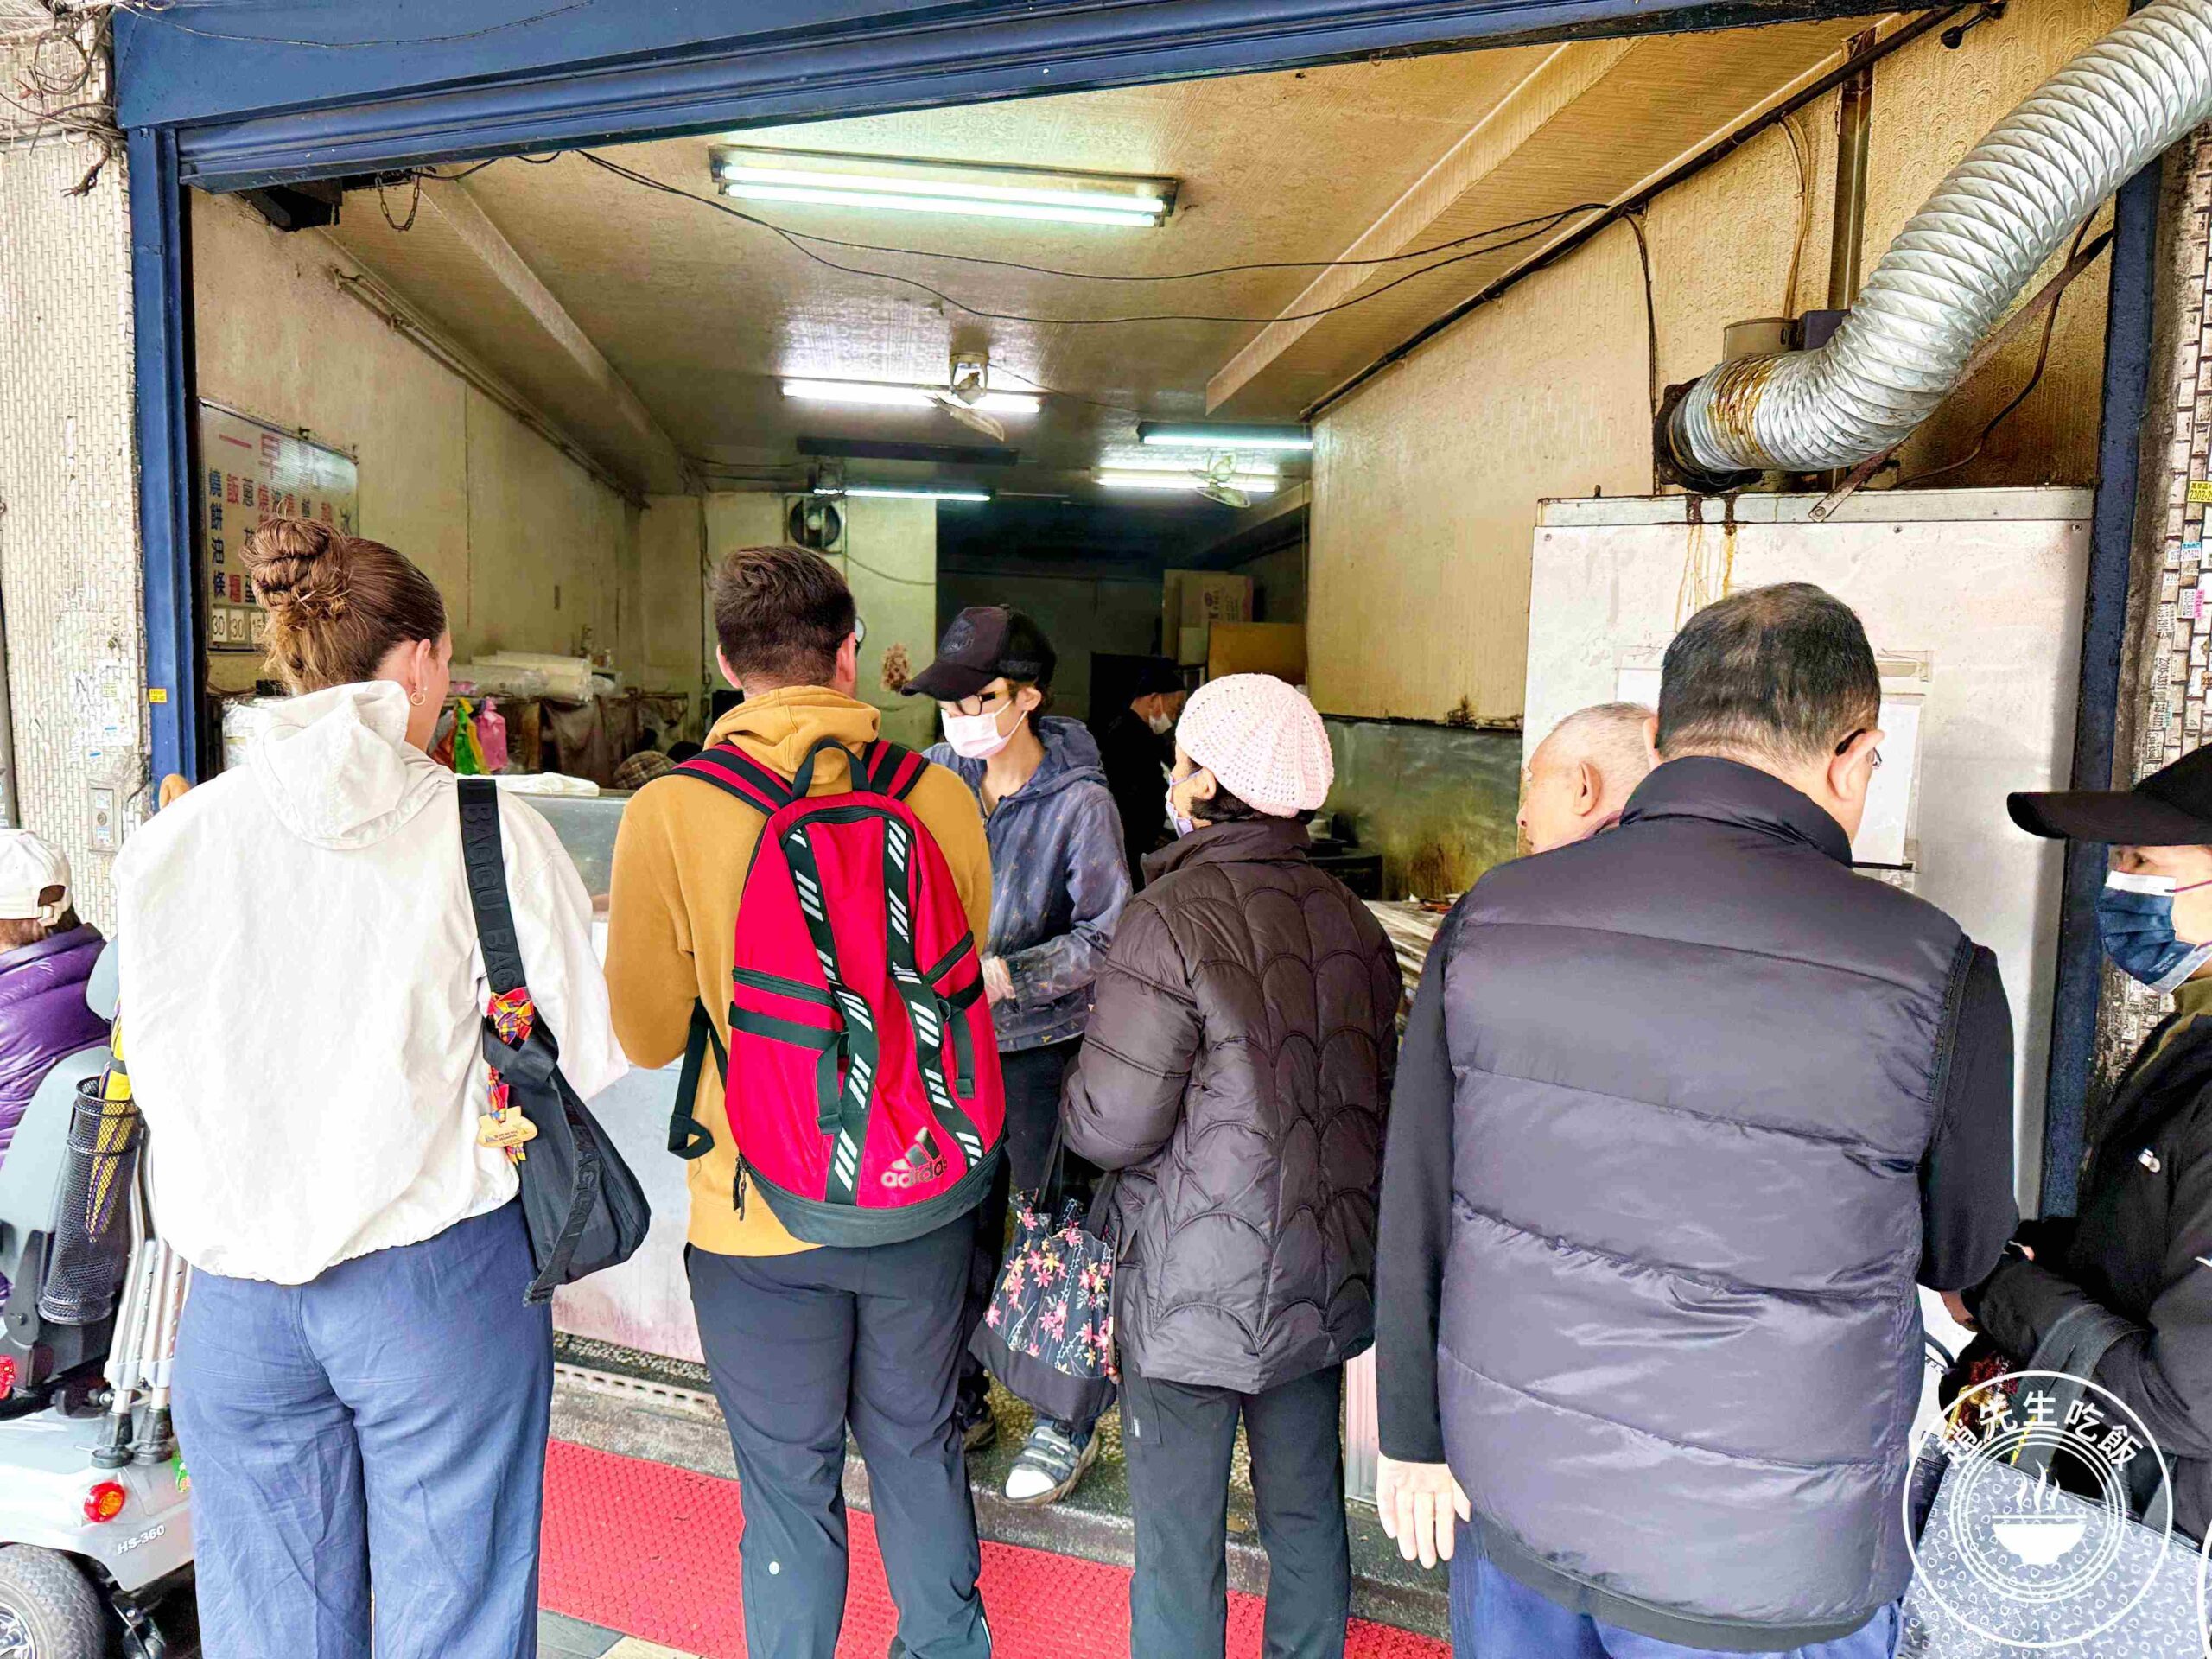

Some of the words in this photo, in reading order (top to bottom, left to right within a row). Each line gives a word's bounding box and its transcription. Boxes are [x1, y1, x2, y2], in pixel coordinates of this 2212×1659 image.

[212, 615, 225, 635] 30
[230, 619, 243, 638] 30
[880, 1155, 948, 1188] adidas
[117, 1524, 165, 1554] HS-360
